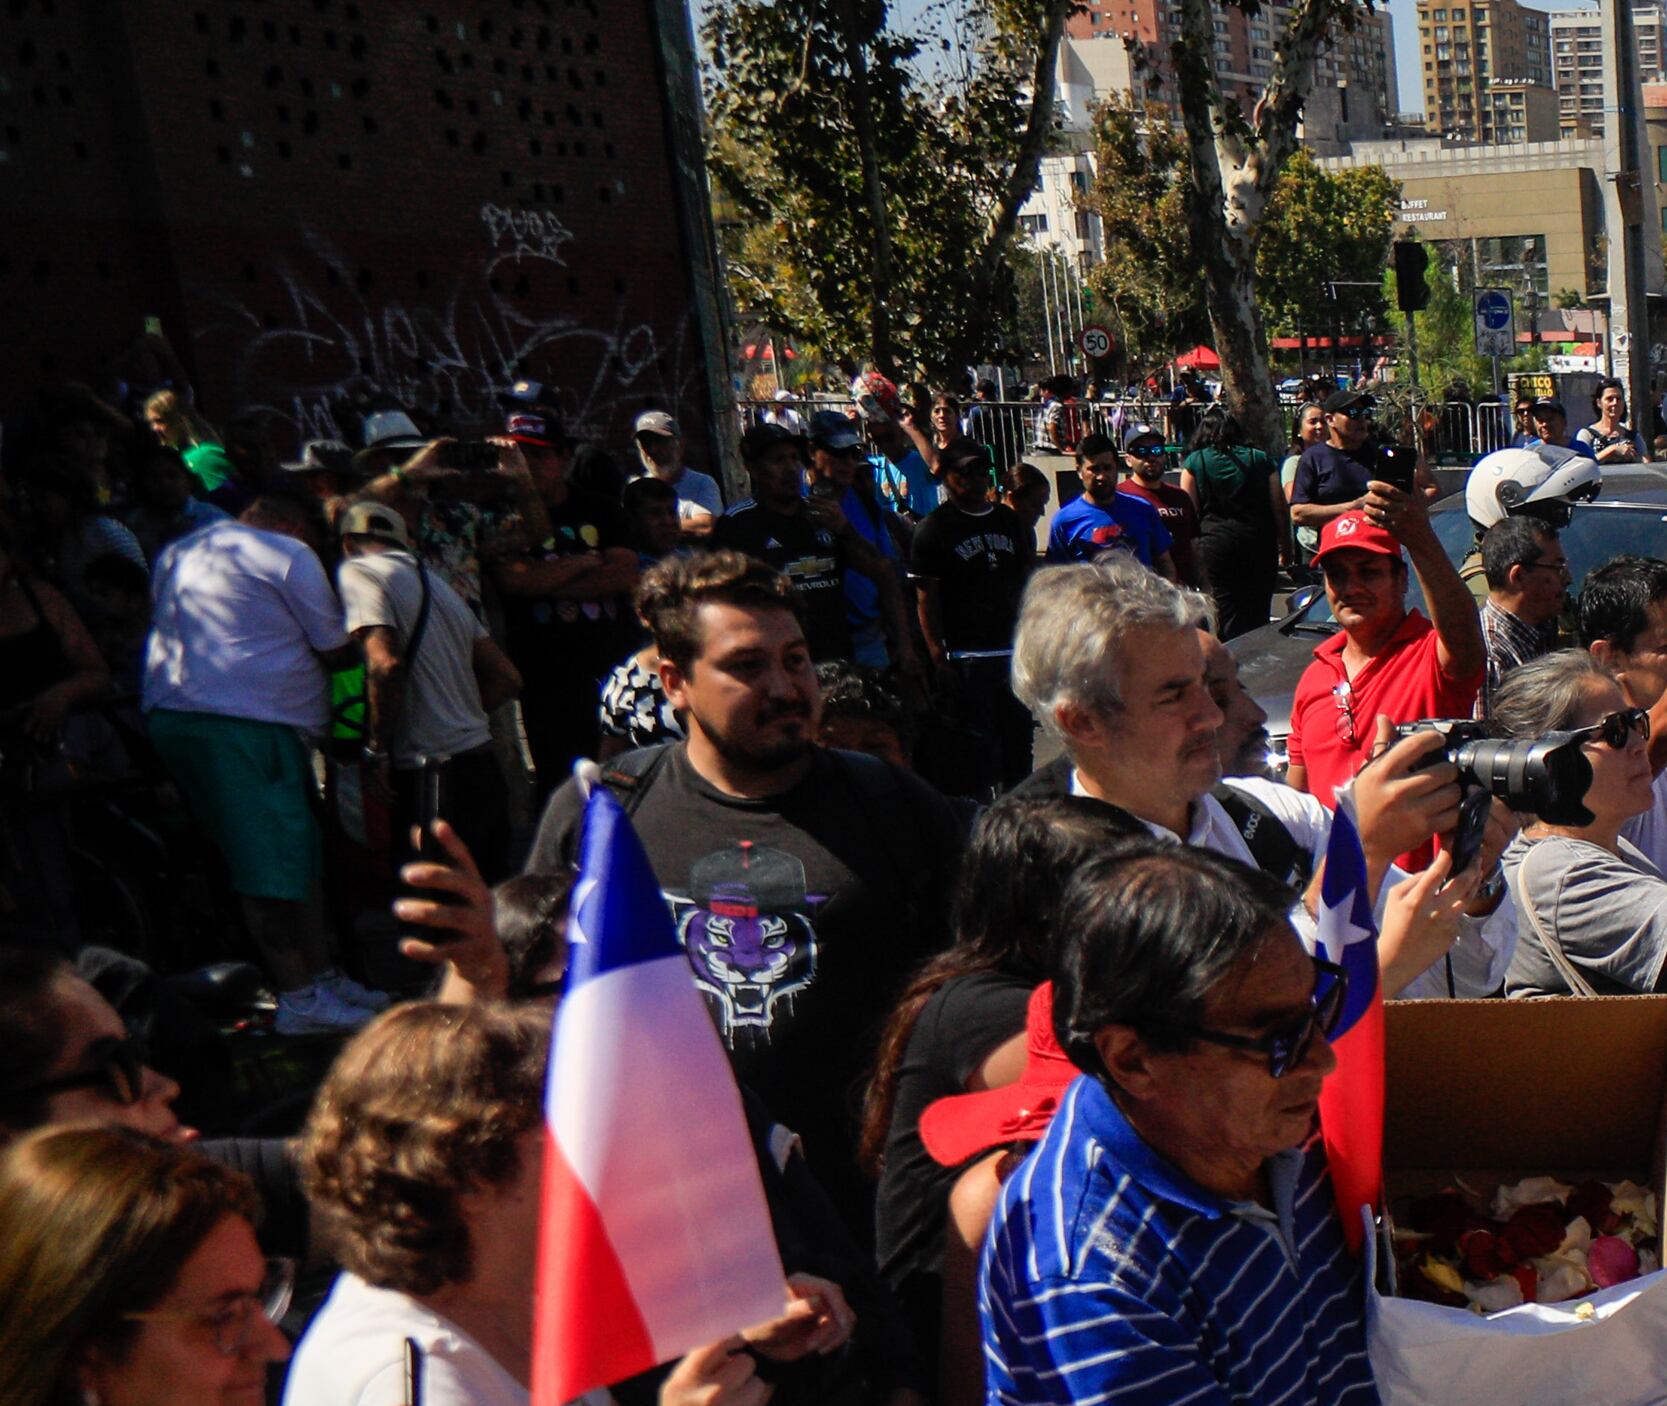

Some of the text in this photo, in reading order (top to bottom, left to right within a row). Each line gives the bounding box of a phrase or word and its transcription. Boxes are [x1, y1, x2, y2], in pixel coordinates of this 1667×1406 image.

[1402, 211, 1447, 222] RESTAURANT
[1086, 335, 1109, 352] 50
[793, 578, 839, 591] HEVROLET
